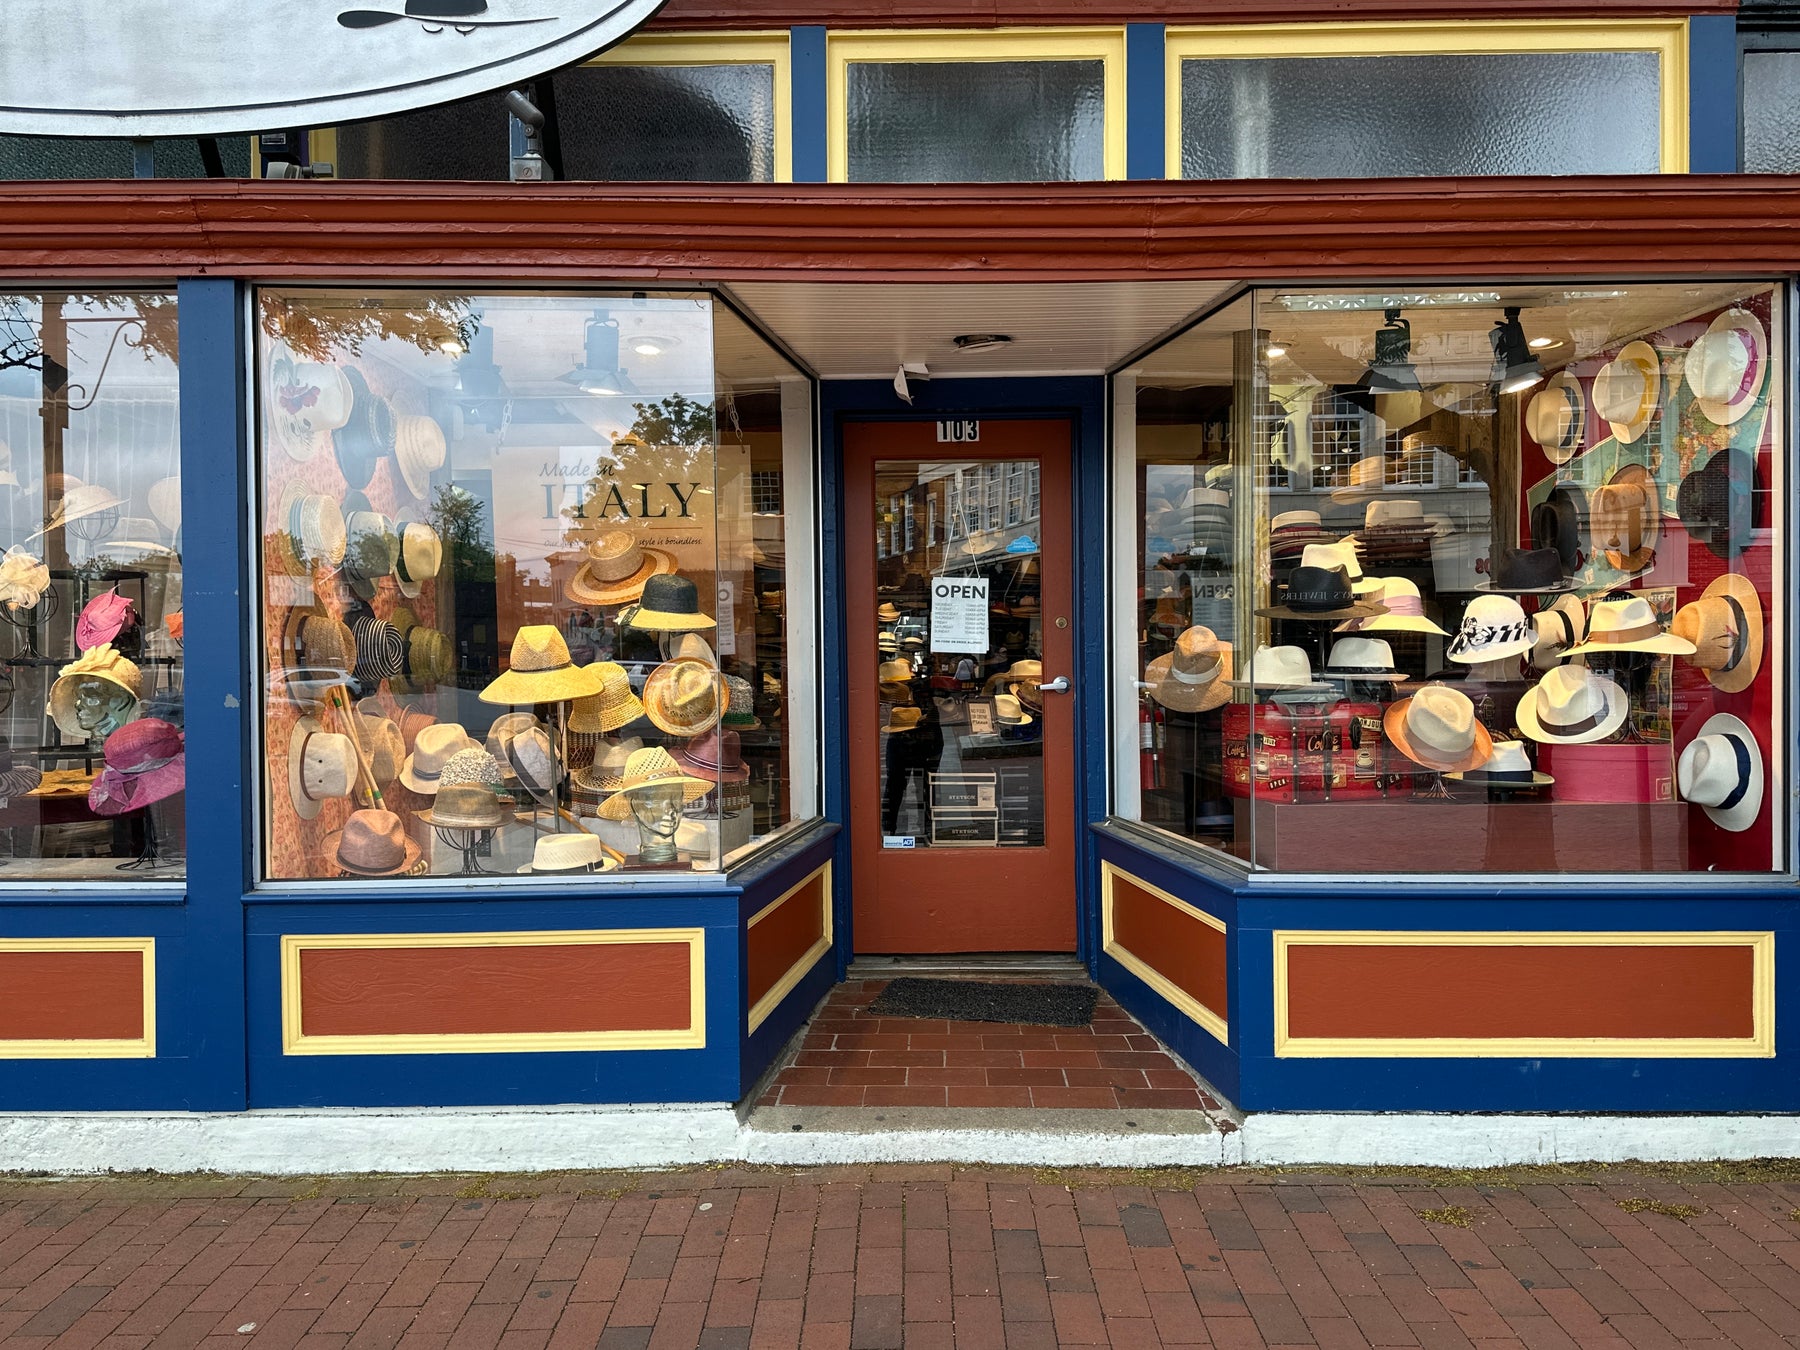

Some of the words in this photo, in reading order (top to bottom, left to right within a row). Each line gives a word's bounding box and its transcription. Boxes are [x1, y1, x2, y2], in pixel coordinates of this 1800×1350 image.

[940, 420, 978, 440] 103
[539, 459, 590, 477] Made
[596, 464, 615, 477] in
[541, 482, 701, 519] ITALY
[638, 537, 656, 546] style
[657, 537, 663, 545] is
[664, 537, 703, 545] boundless.
[935, 584, 986, 599] OPEN
[1376, 773, 1400, 789] OEN
